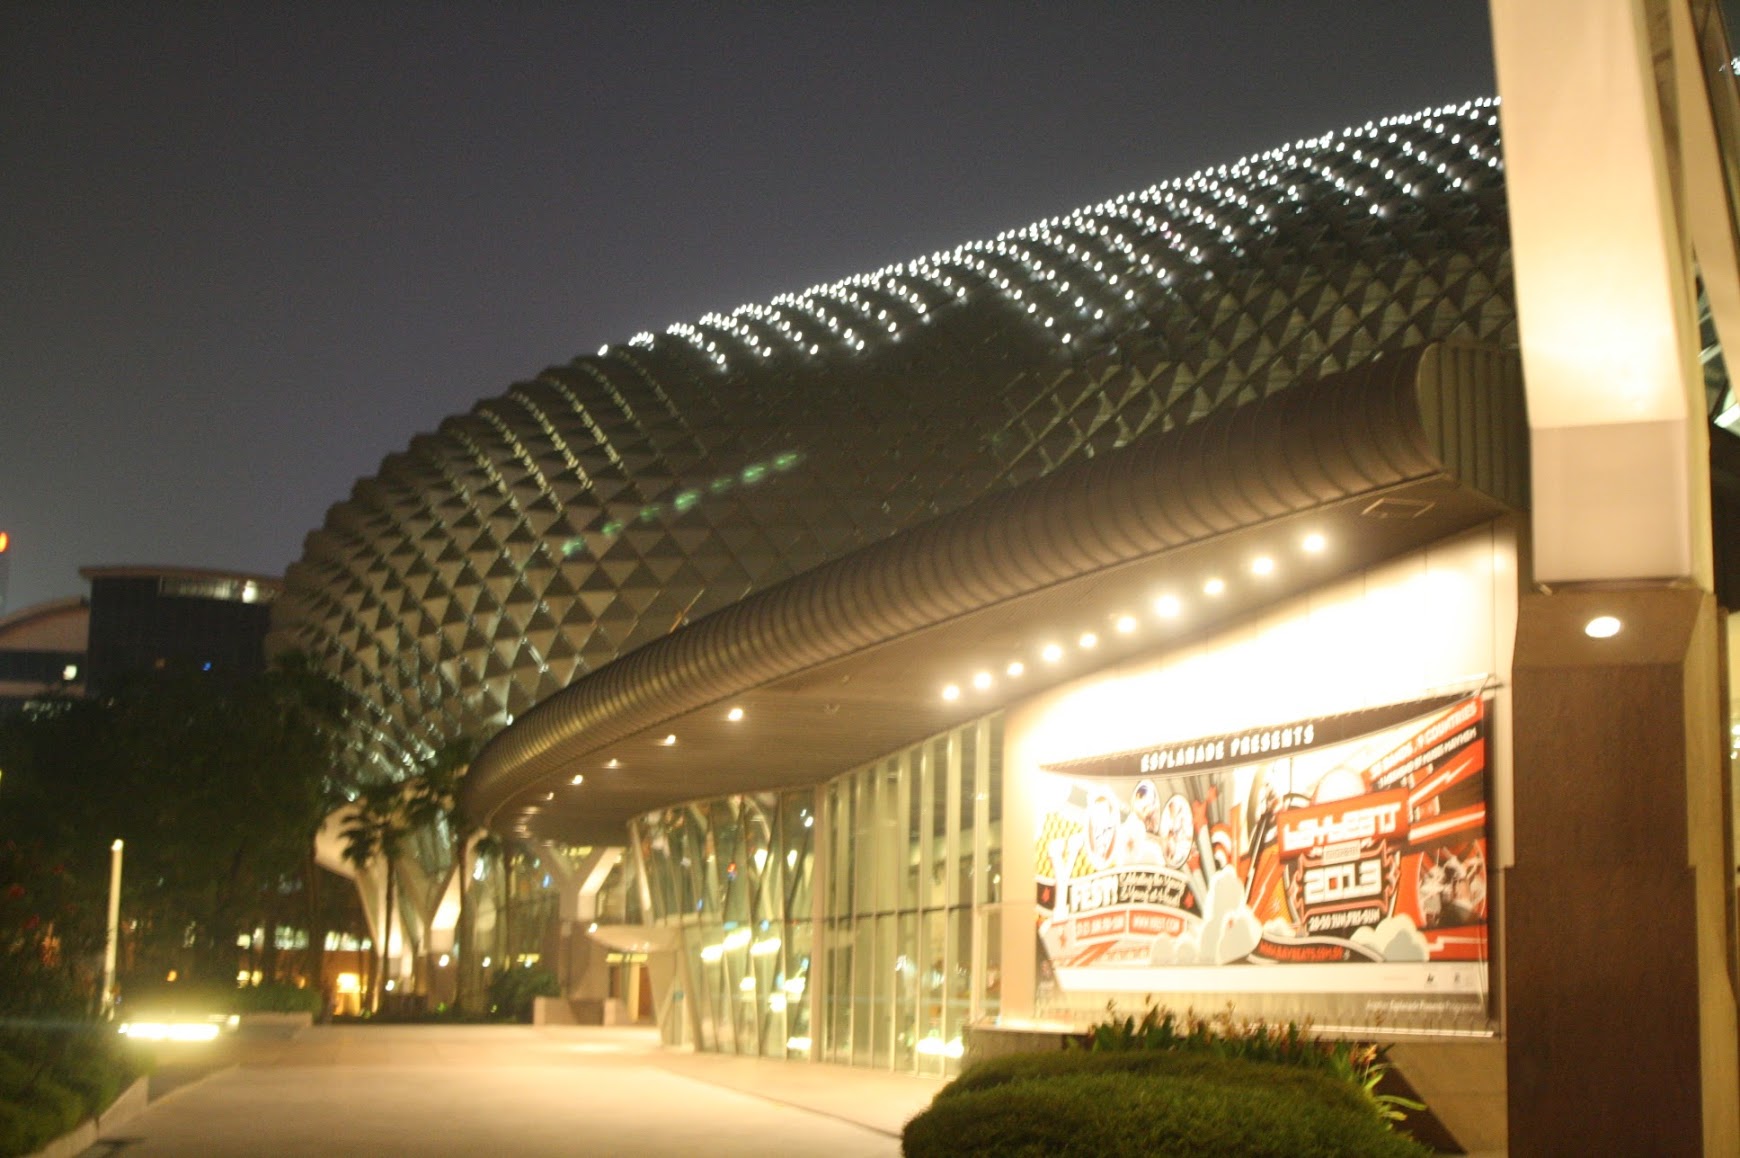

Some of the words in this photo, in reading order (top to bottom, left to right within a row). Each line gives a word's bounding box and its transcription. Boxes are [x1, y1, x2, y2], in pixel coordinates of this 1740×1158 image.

[1140, 740, 1225, 773] ESPLANADE
[1230, 724, 1315, 757] PRESENTS
[1303, 859, 1382, 905] 2013
